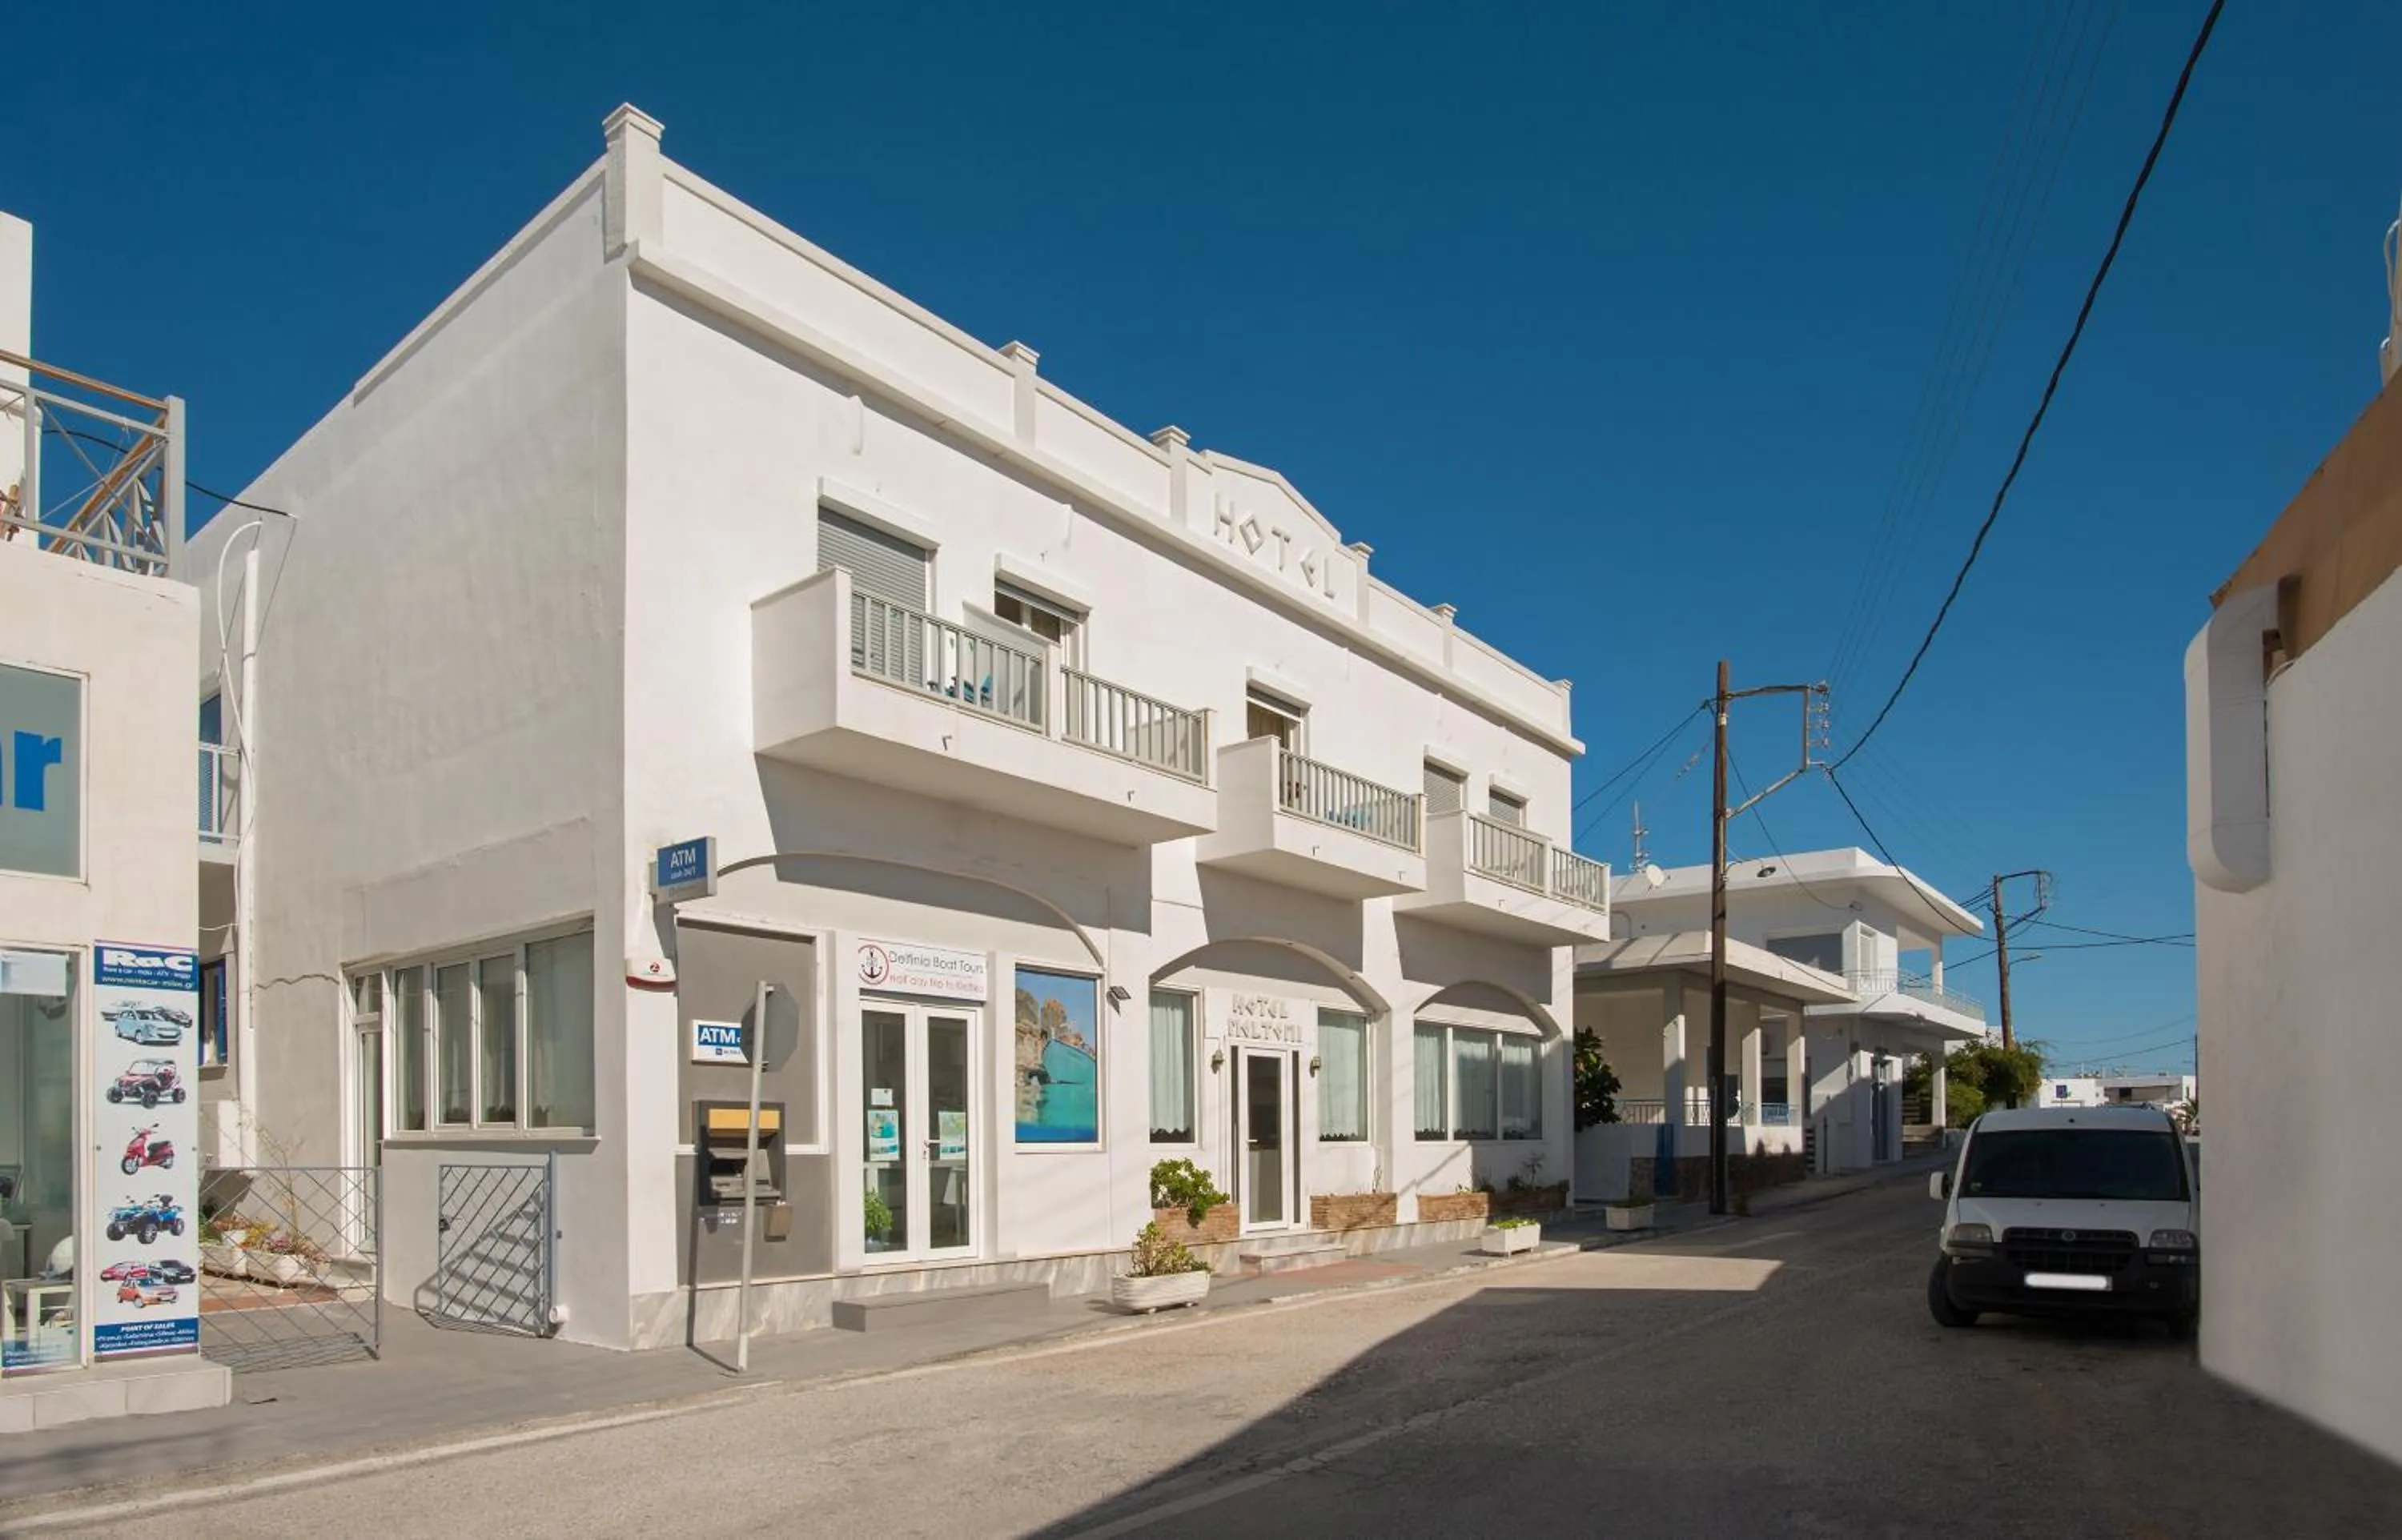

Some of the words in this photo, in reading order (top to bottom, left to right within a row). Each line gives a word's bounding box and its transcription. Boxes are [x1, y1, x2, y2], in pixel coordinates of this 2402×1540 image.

[670, 847, 696, 868] ATM
[933, 956, 958, 970] Boat
[959, 959, 984, 974] Tours
[699, 1027, 736, 1045] ATM
